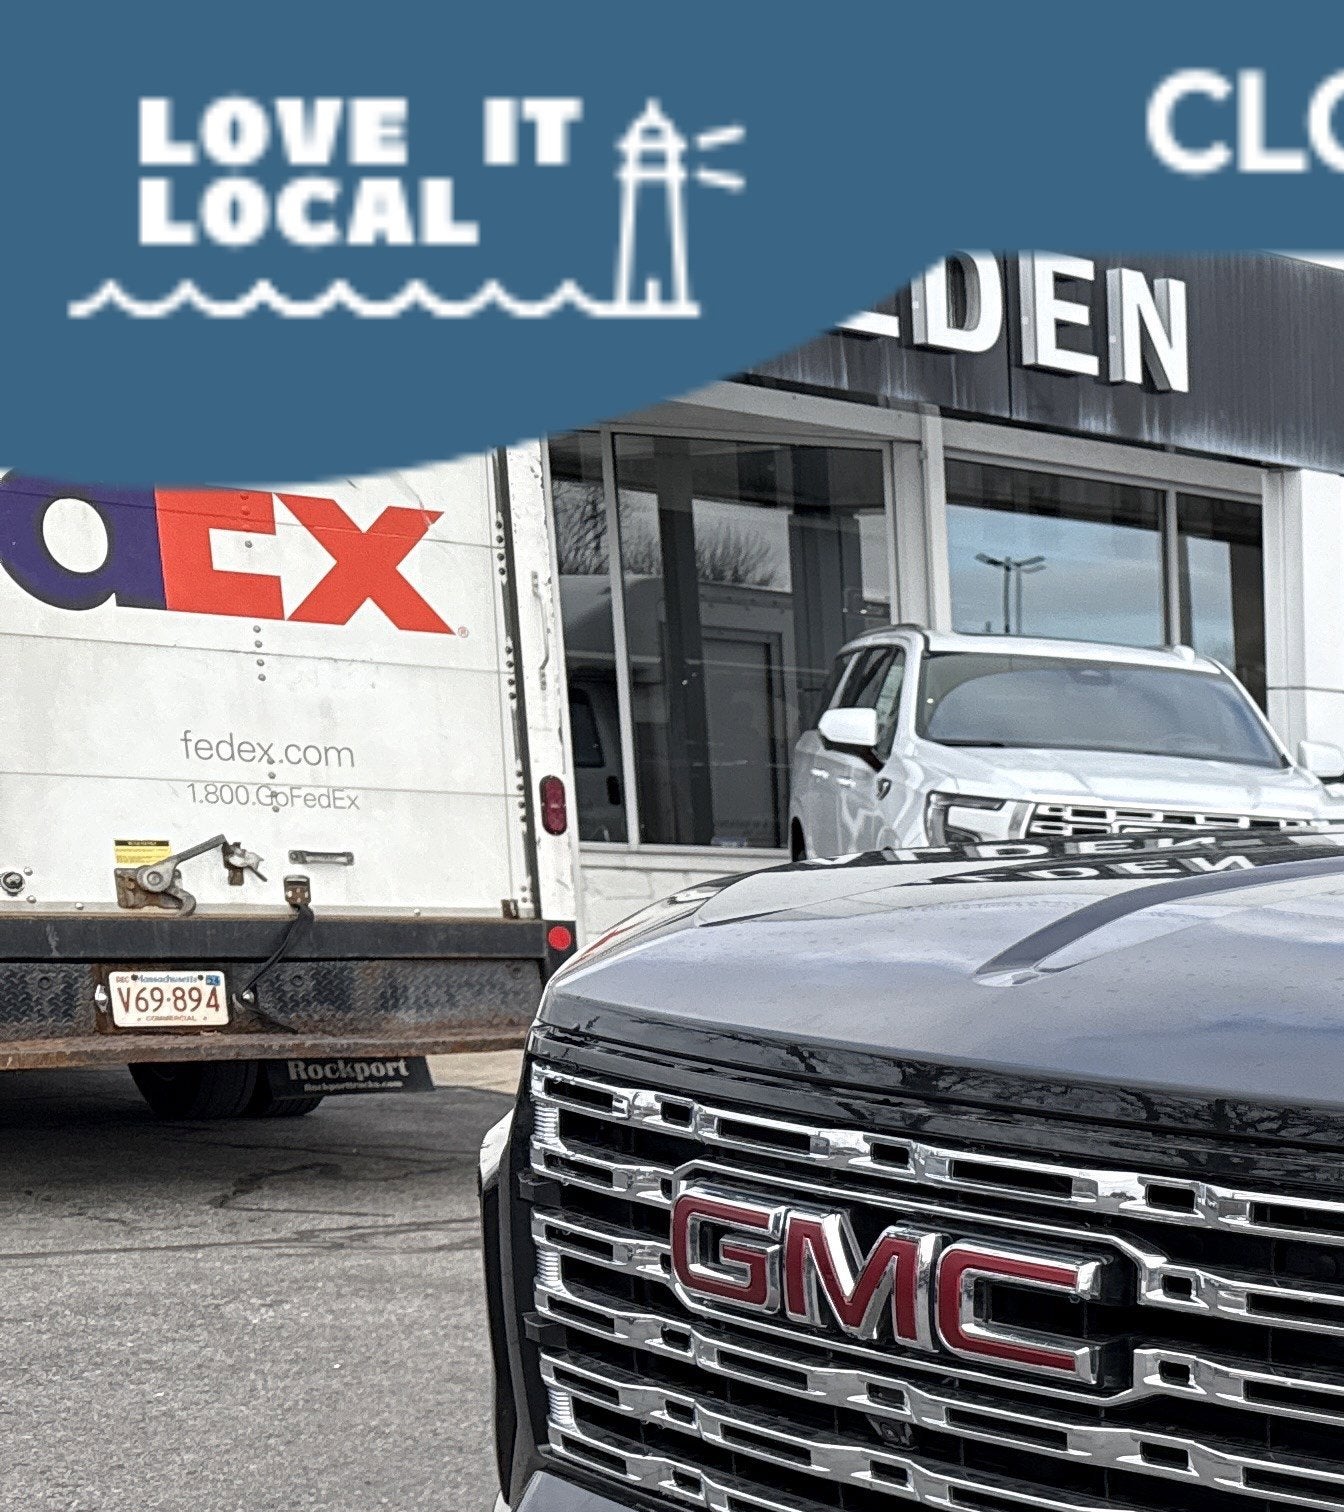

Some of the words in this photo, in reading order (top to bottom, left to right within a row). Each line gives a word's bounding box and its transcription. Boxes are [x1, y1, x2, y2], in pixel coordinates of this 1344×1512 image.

[835, 250, 1189, 393] DEN
[180, 730, 355, 767] fedex.com
[187, 783, 360, 810] 1.800.GoFedEx
[287, 1058, 409, 1080] Rockport
[671, 1186, 1101, 1385] GMC
